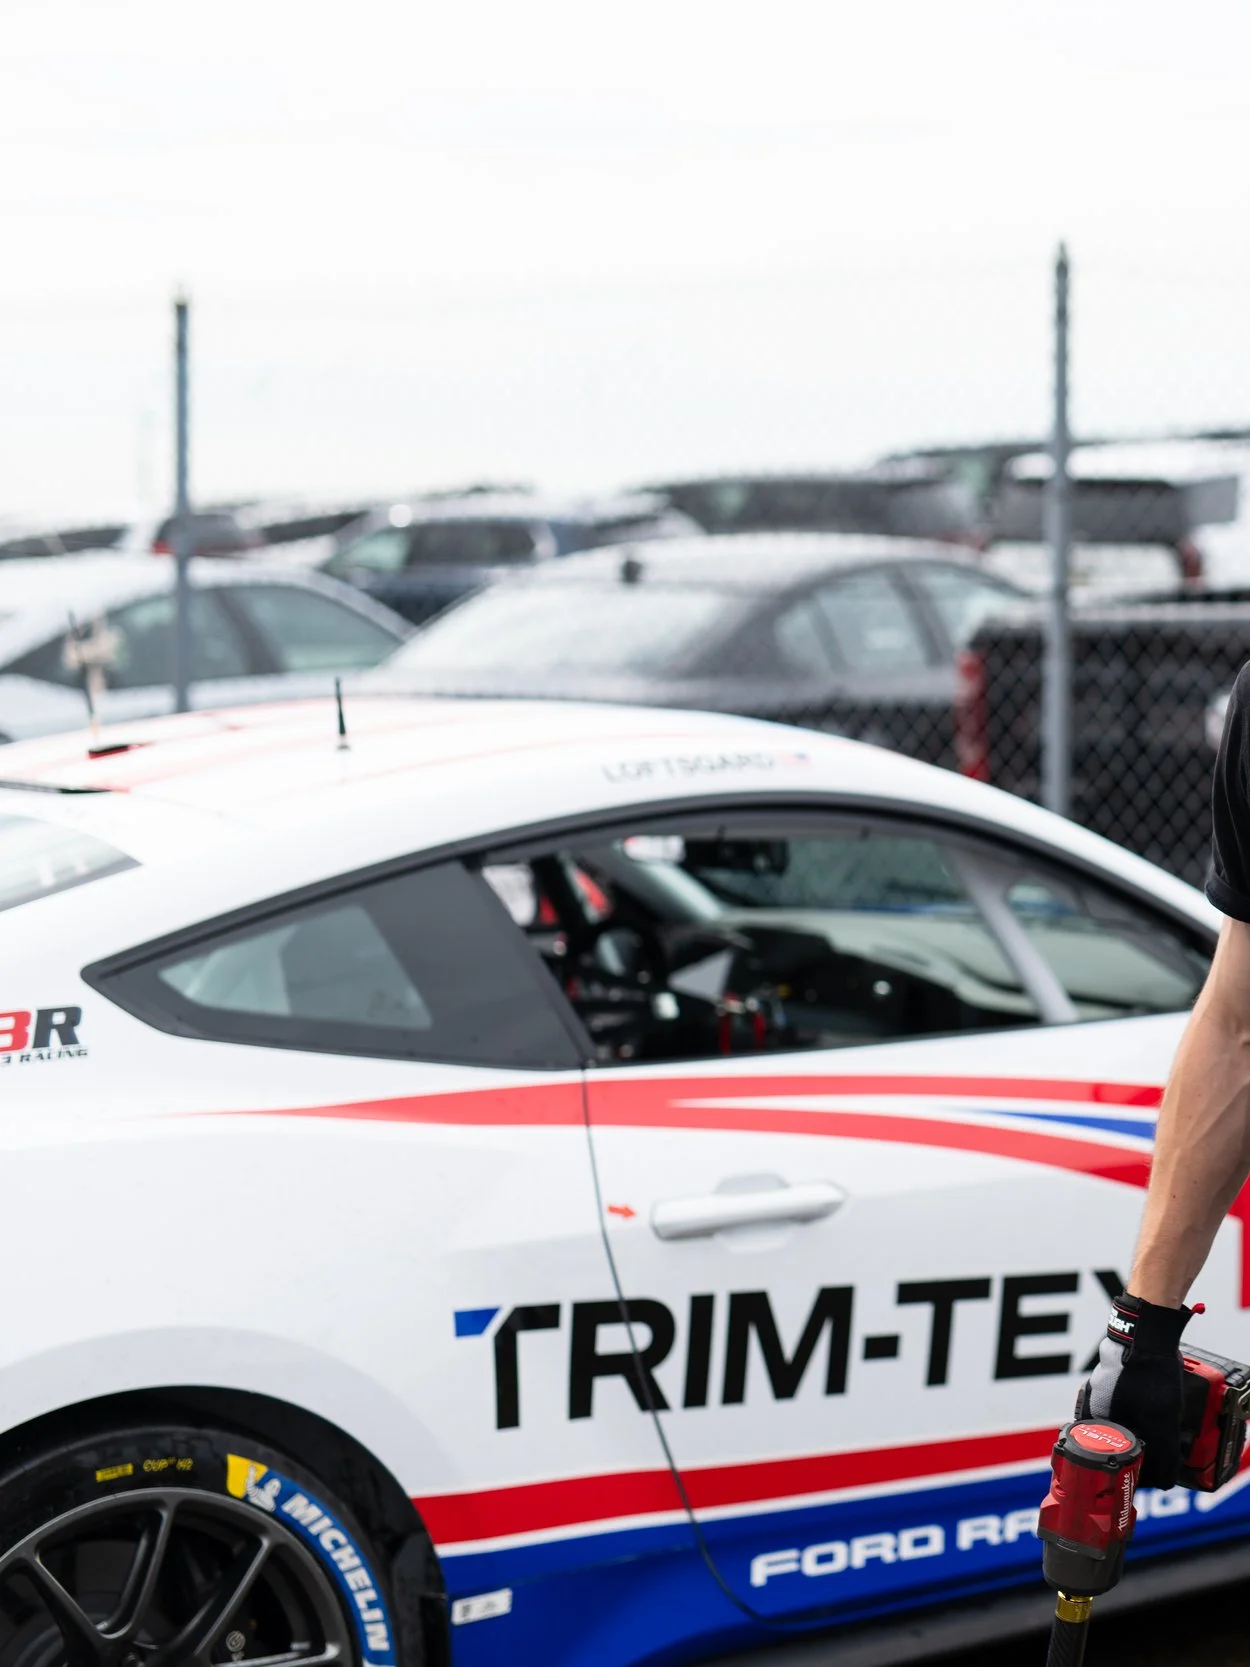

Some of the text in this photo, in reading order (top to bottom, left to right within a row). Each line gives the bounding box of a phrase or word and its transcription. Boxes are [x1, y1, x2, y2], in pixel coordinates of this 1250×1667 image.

[749, 1485, 1190, 1588] FORD RAG
[1118, 1471, 1131, 1531] Milwaukee
[281, 1492, 390, 1651] MICHELIN
